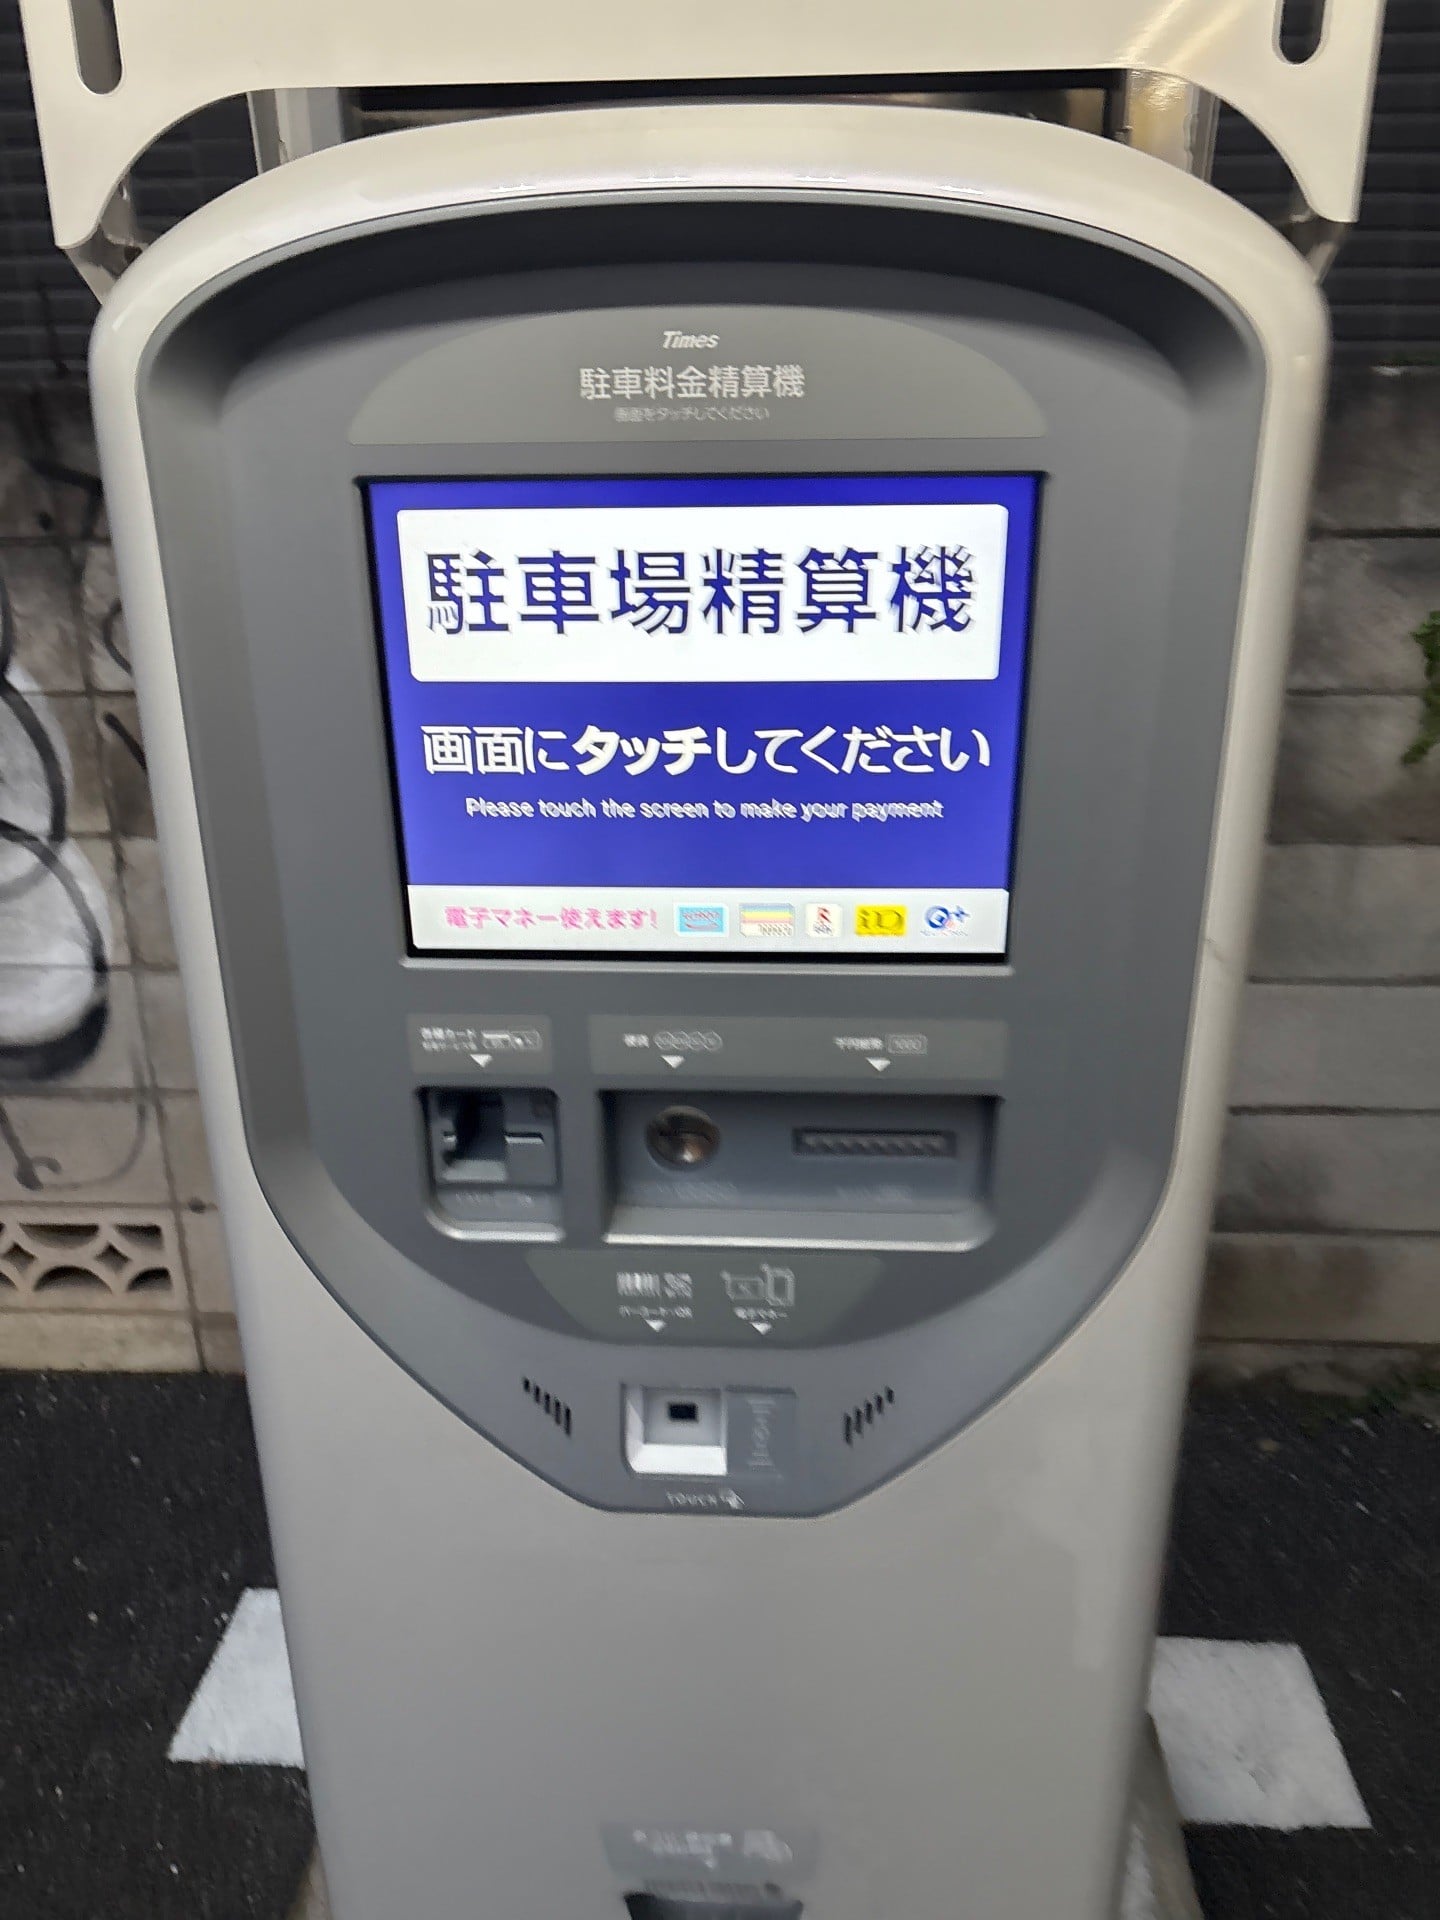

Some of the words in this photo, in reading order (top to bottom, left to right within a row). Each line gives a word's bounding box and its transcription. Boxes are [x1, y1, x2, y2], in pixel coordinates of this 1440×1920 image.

[662, 330, 720, 349] Times
[579, 364, 806, 400] 駐車料金精算機
[425, 543, 977, 637] 駐車場精算機
[420, 724, 991, 776] 画面にタッチしてください
[465, 797, 534, 818] Please
[537, 798, 597, 818] touch
[600, 798, 636, 818] the
[639, 801, 710, 819] screen
[712, 799, 737, 819] to
[739, 798, 798, 819] make
[799, 802, 849, 823] your
[850, 799, 944, 823] payment
